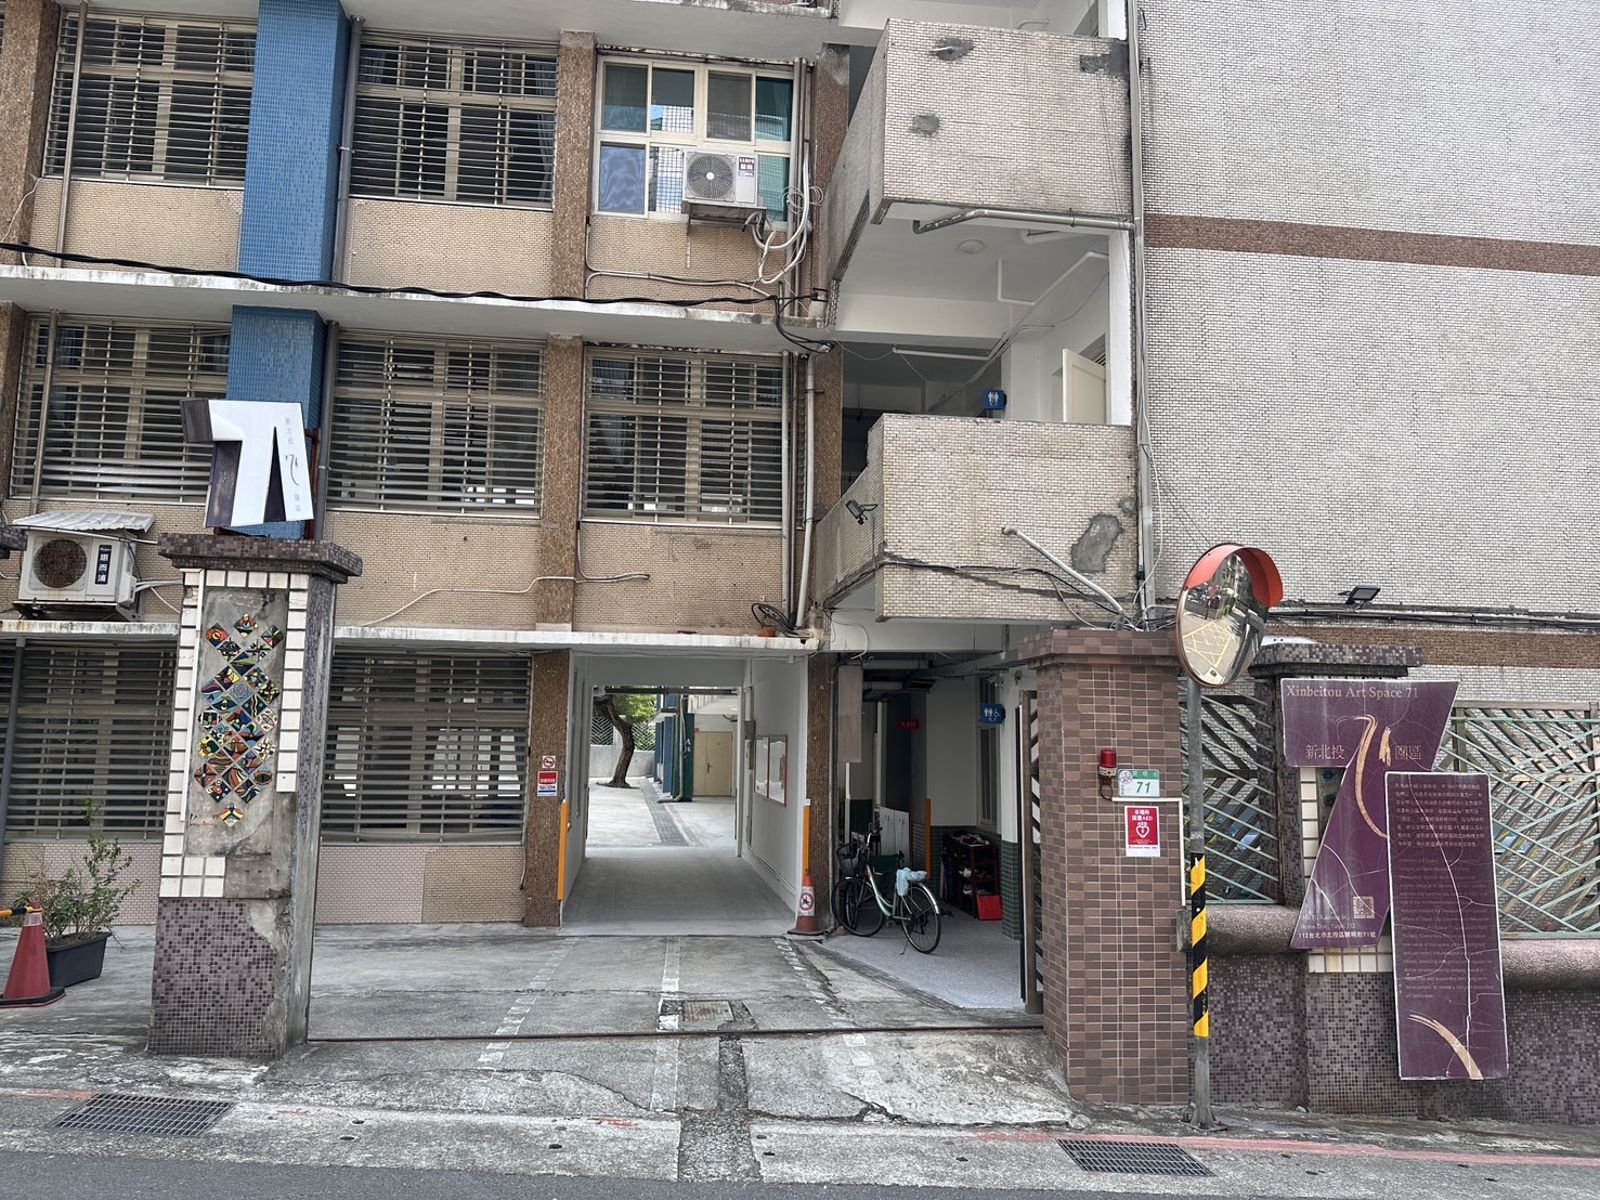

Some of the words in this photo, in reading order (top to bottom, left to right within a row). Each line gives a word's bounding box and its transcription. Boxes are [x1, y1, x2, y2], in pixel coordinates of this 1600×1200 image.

[1286, 685, 1342, 697] Xinbeitou
[1346, 687, 1365, 698] Art
[1369, 687, 1402, 700] Space
[1406, 688, 1418, 698] 71
[1305, 744, 1344, 760] 新北投
[1136, 781, 1150, 793] 71
